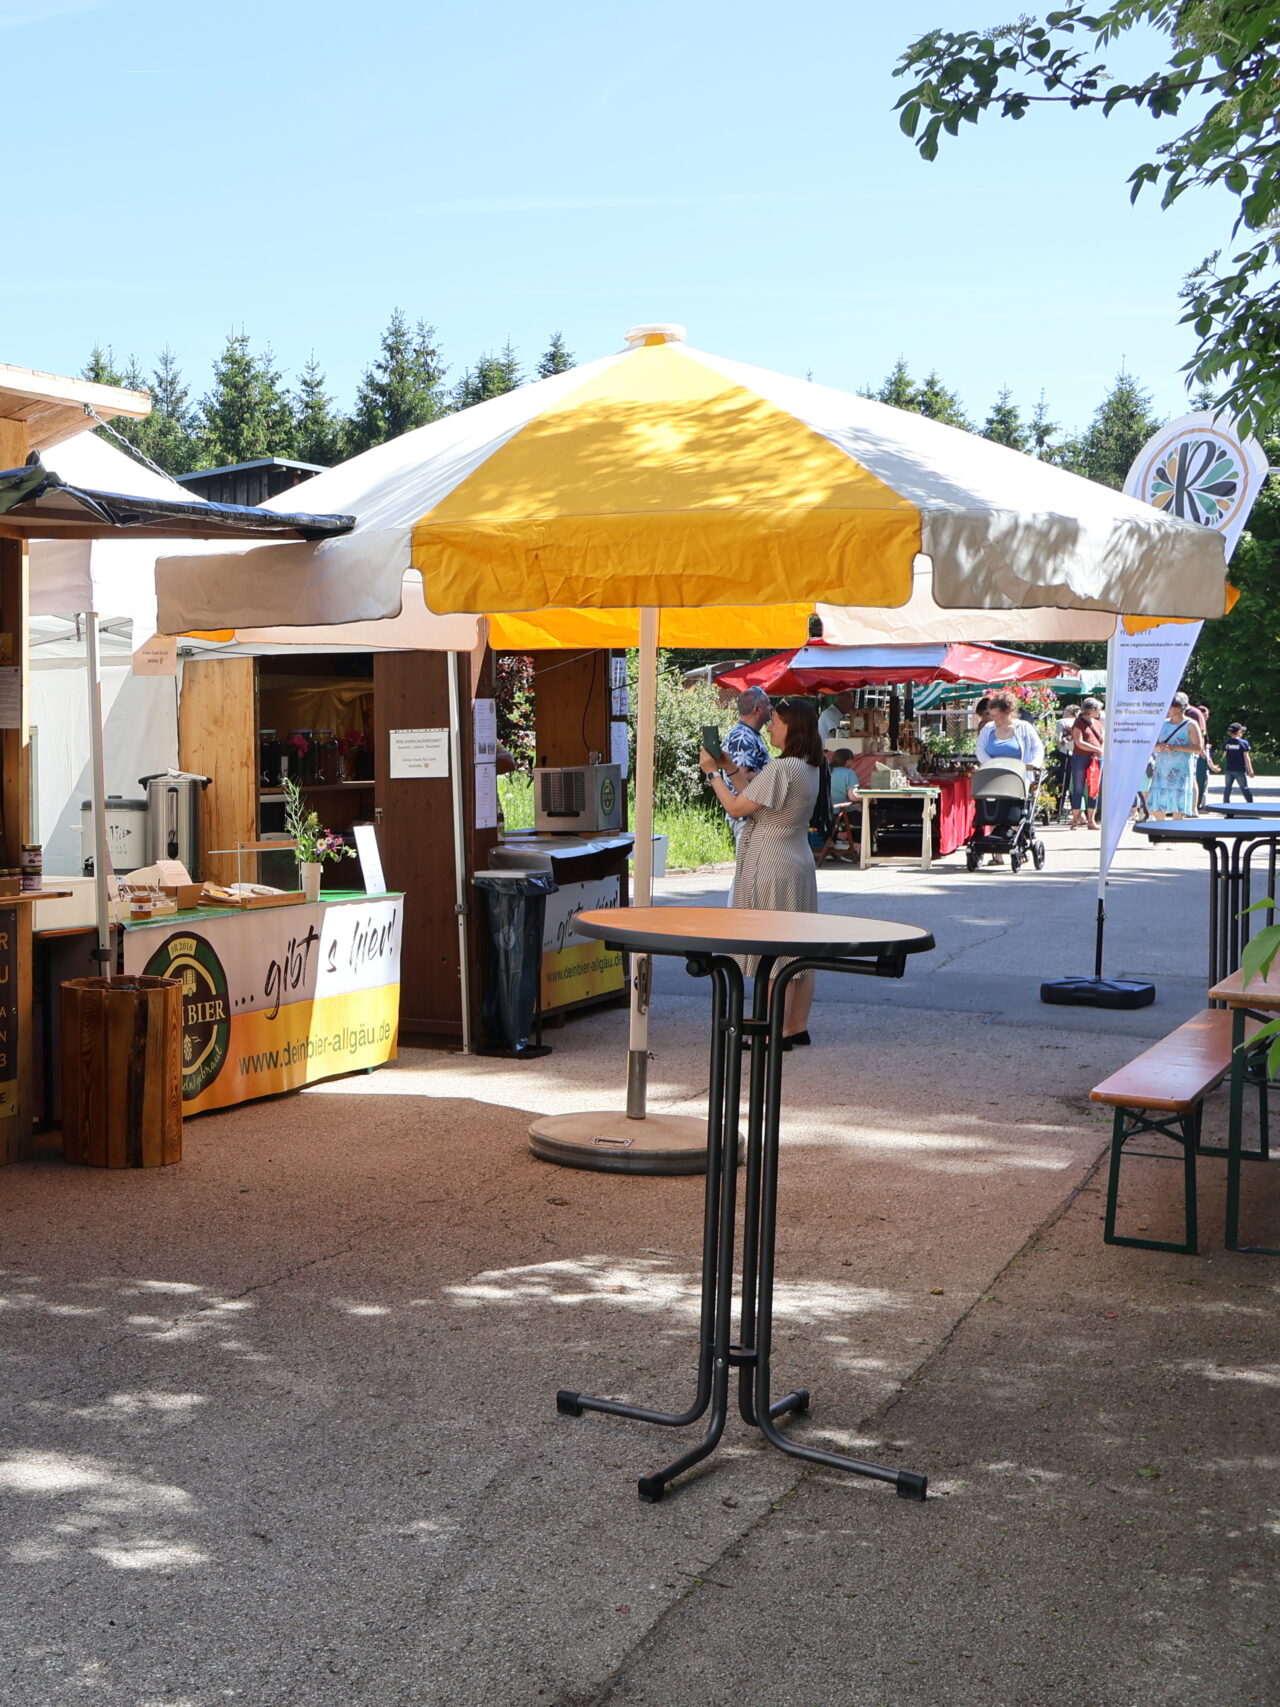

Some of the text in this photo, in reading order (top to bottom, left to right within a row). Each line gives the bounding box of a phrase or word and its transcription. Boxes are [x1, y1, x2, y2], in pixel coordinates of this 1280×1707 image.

[264, 924, 320, 1020] gibt
[187, 999, 226, 1025] BIER
[239, 1021, 391, 1076] www.deinbier-allgäu.de
